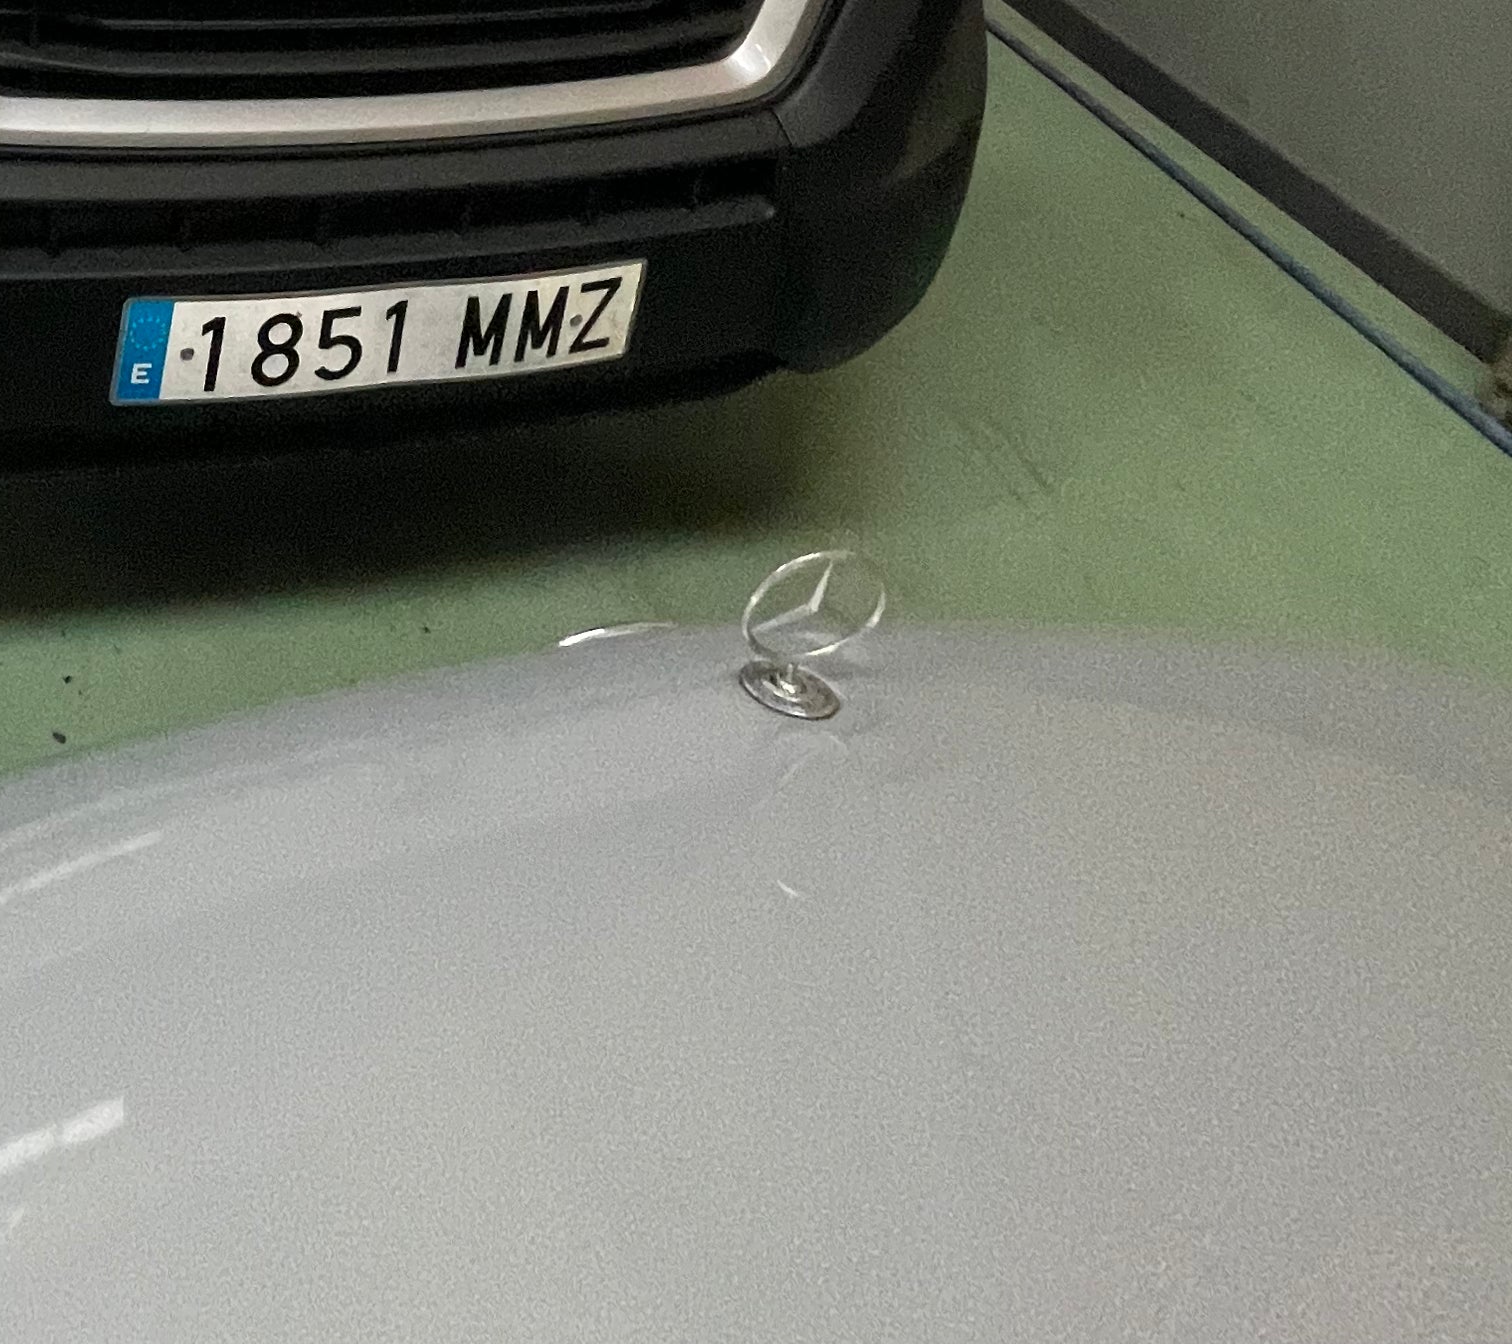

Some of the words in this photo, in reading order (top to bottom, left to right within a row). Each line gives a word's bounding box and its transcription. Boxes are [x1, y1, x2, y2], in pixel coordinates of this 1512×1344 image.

[200, 300, 410, 393] 1851
[455, 277, 624, 370] MMZ
[130, 362, 153, 384] E
